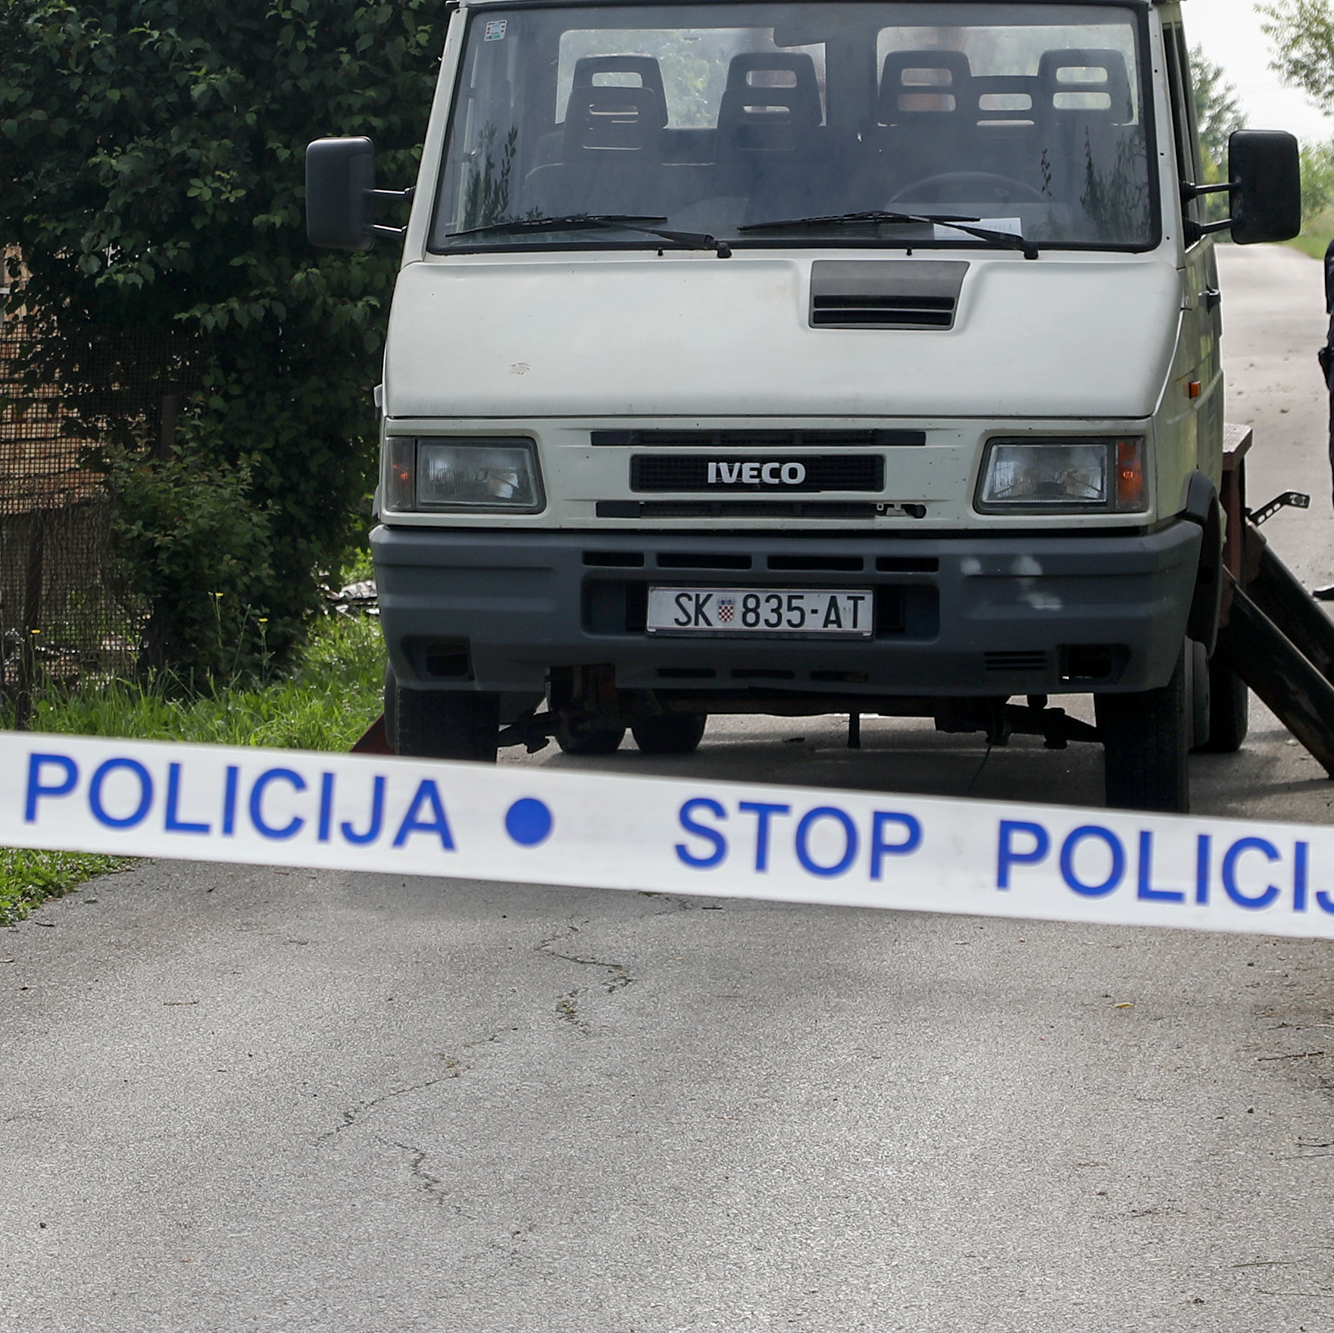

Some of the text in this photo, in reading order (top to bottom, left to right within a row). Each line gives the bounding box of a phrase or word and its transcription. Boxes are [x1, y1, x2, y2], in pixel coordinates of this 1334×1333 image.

[707, 462, 806, 484] IVECO
[674, 593, 865, 629] SK 835-AT
[24, 753, 455, 850] POLICIJA
[675, 797, 923, 879] STOP
